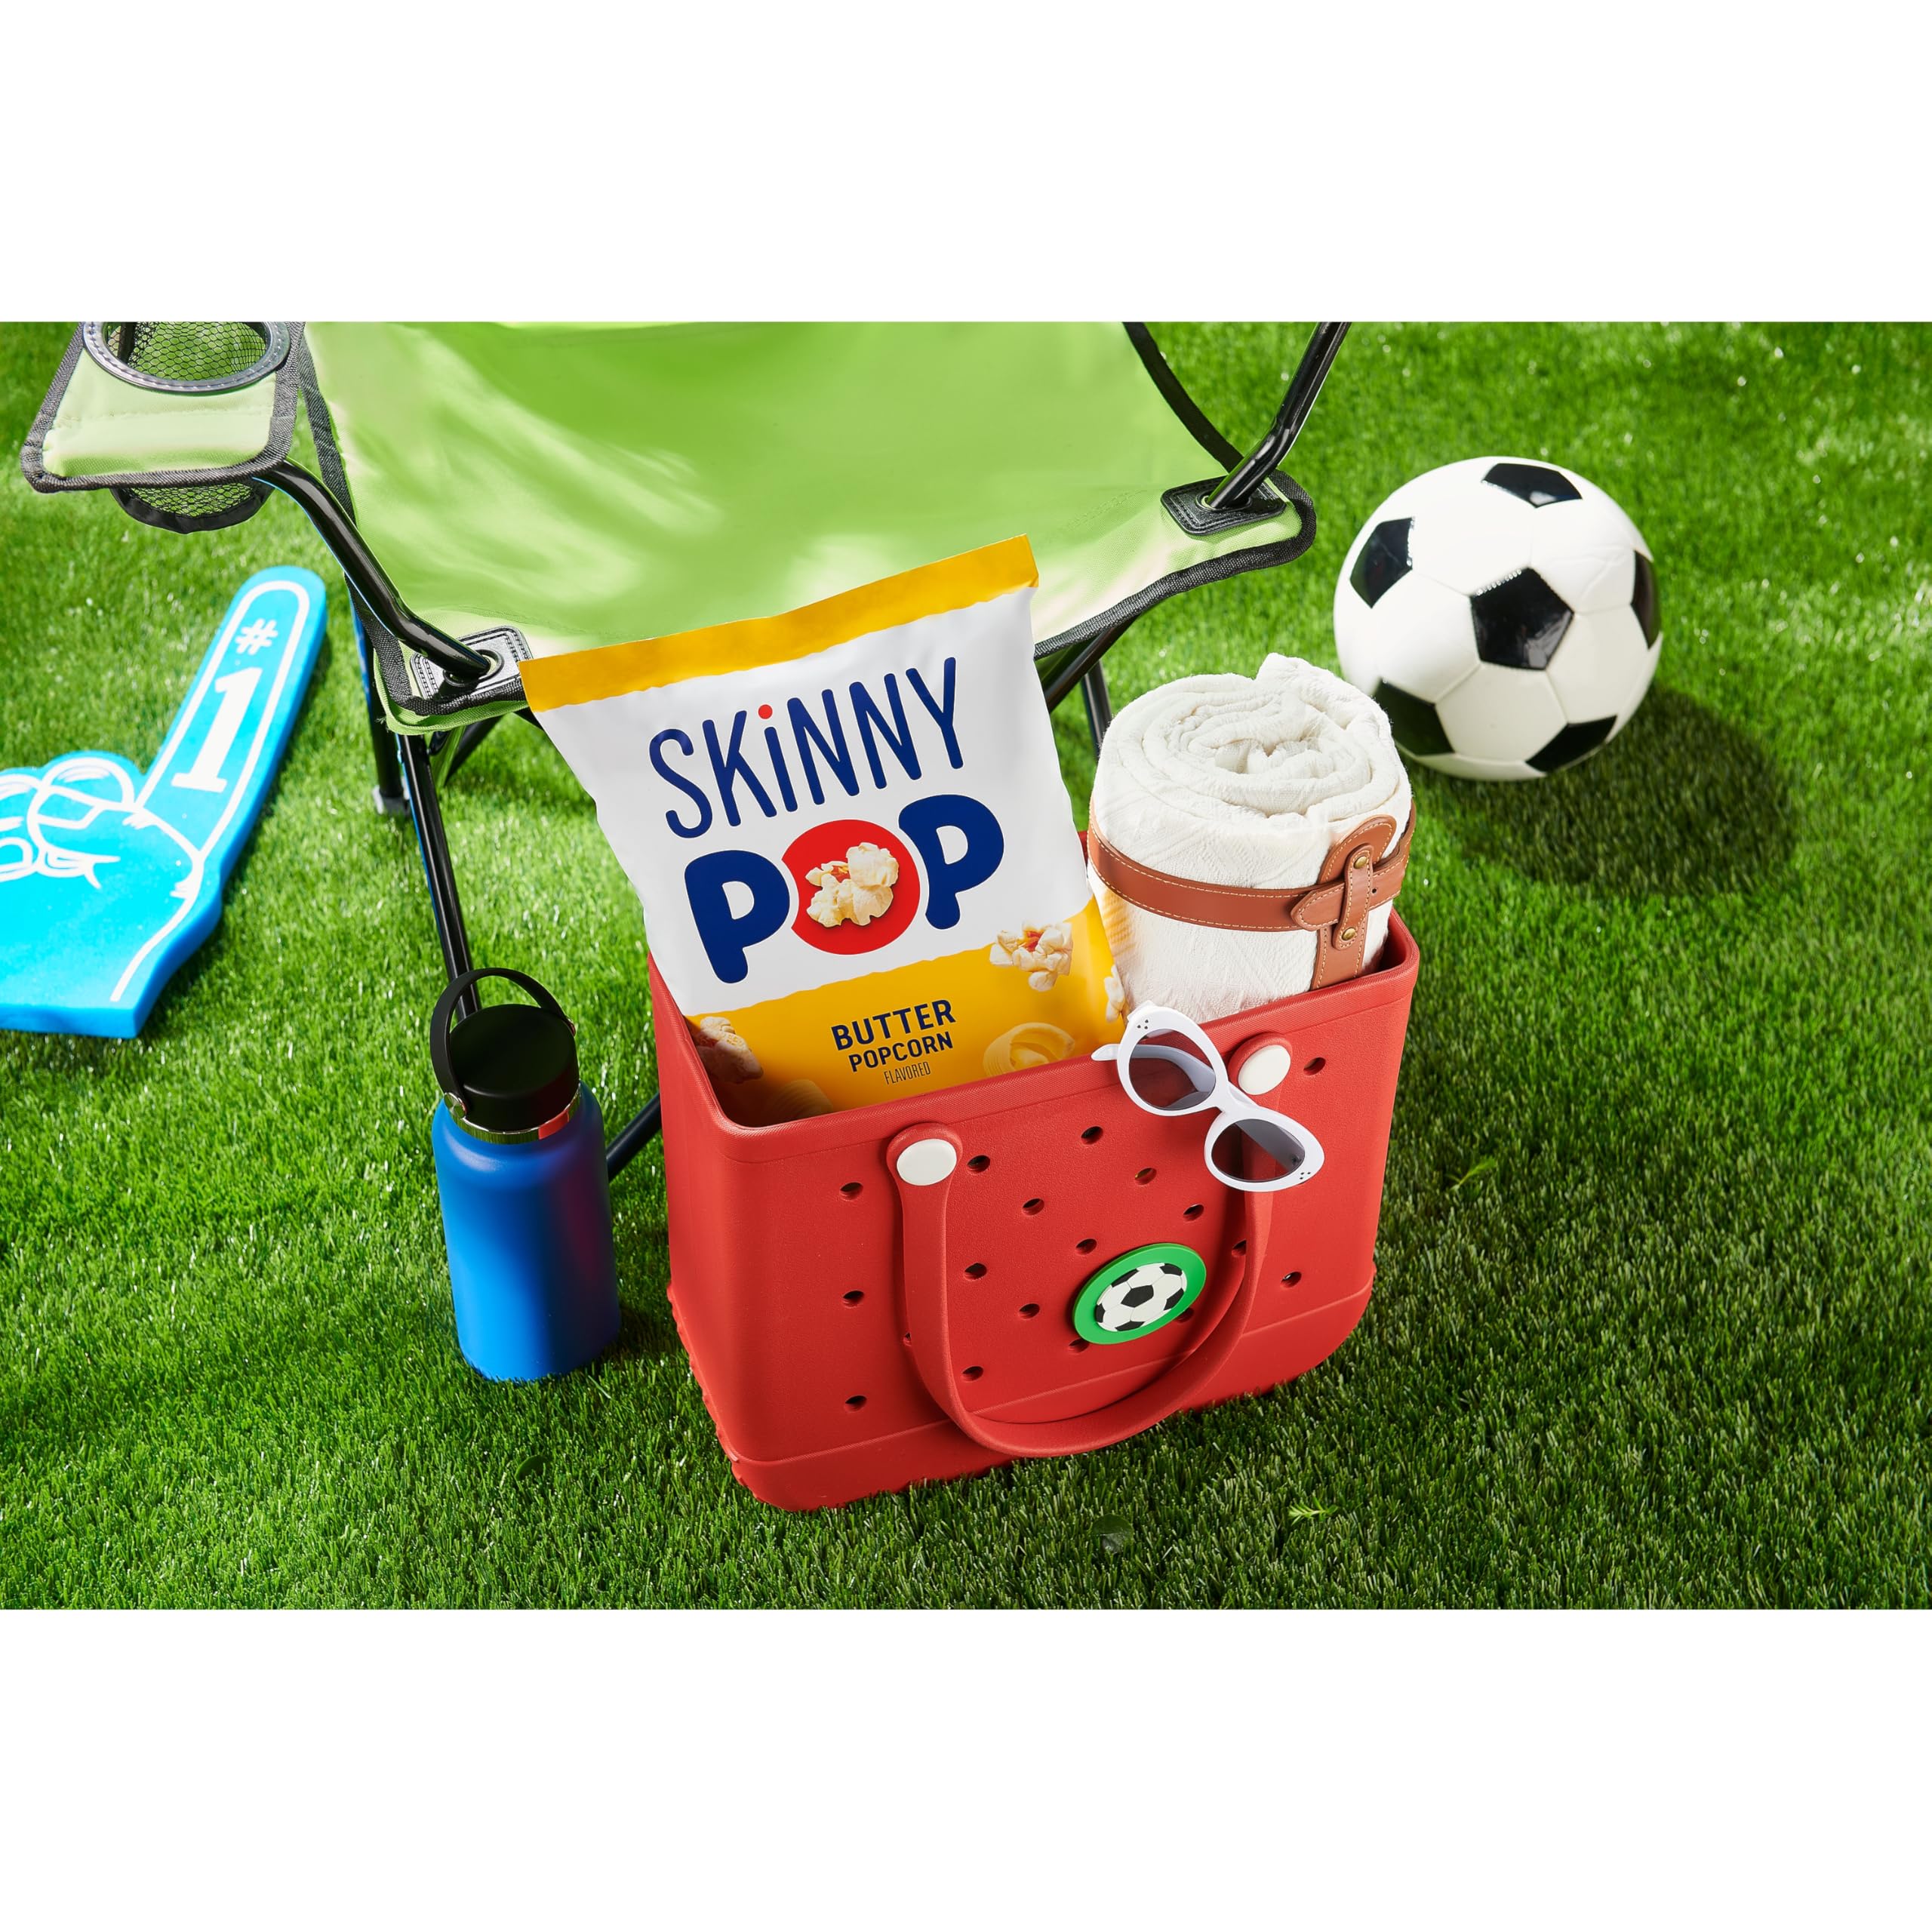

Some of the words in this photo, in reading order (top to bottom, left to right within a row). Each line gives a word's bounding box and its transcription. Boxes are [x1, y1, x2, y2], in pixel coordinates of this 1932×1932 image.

[235, 619, 278, 655] #
[684, 794, 1004, 984] POP
[831, 999, 955, 1051] BUTTER
[848, 1032, 953, 1072] POPCORN
[884, 1061, 931, 1084] FLAVORED
